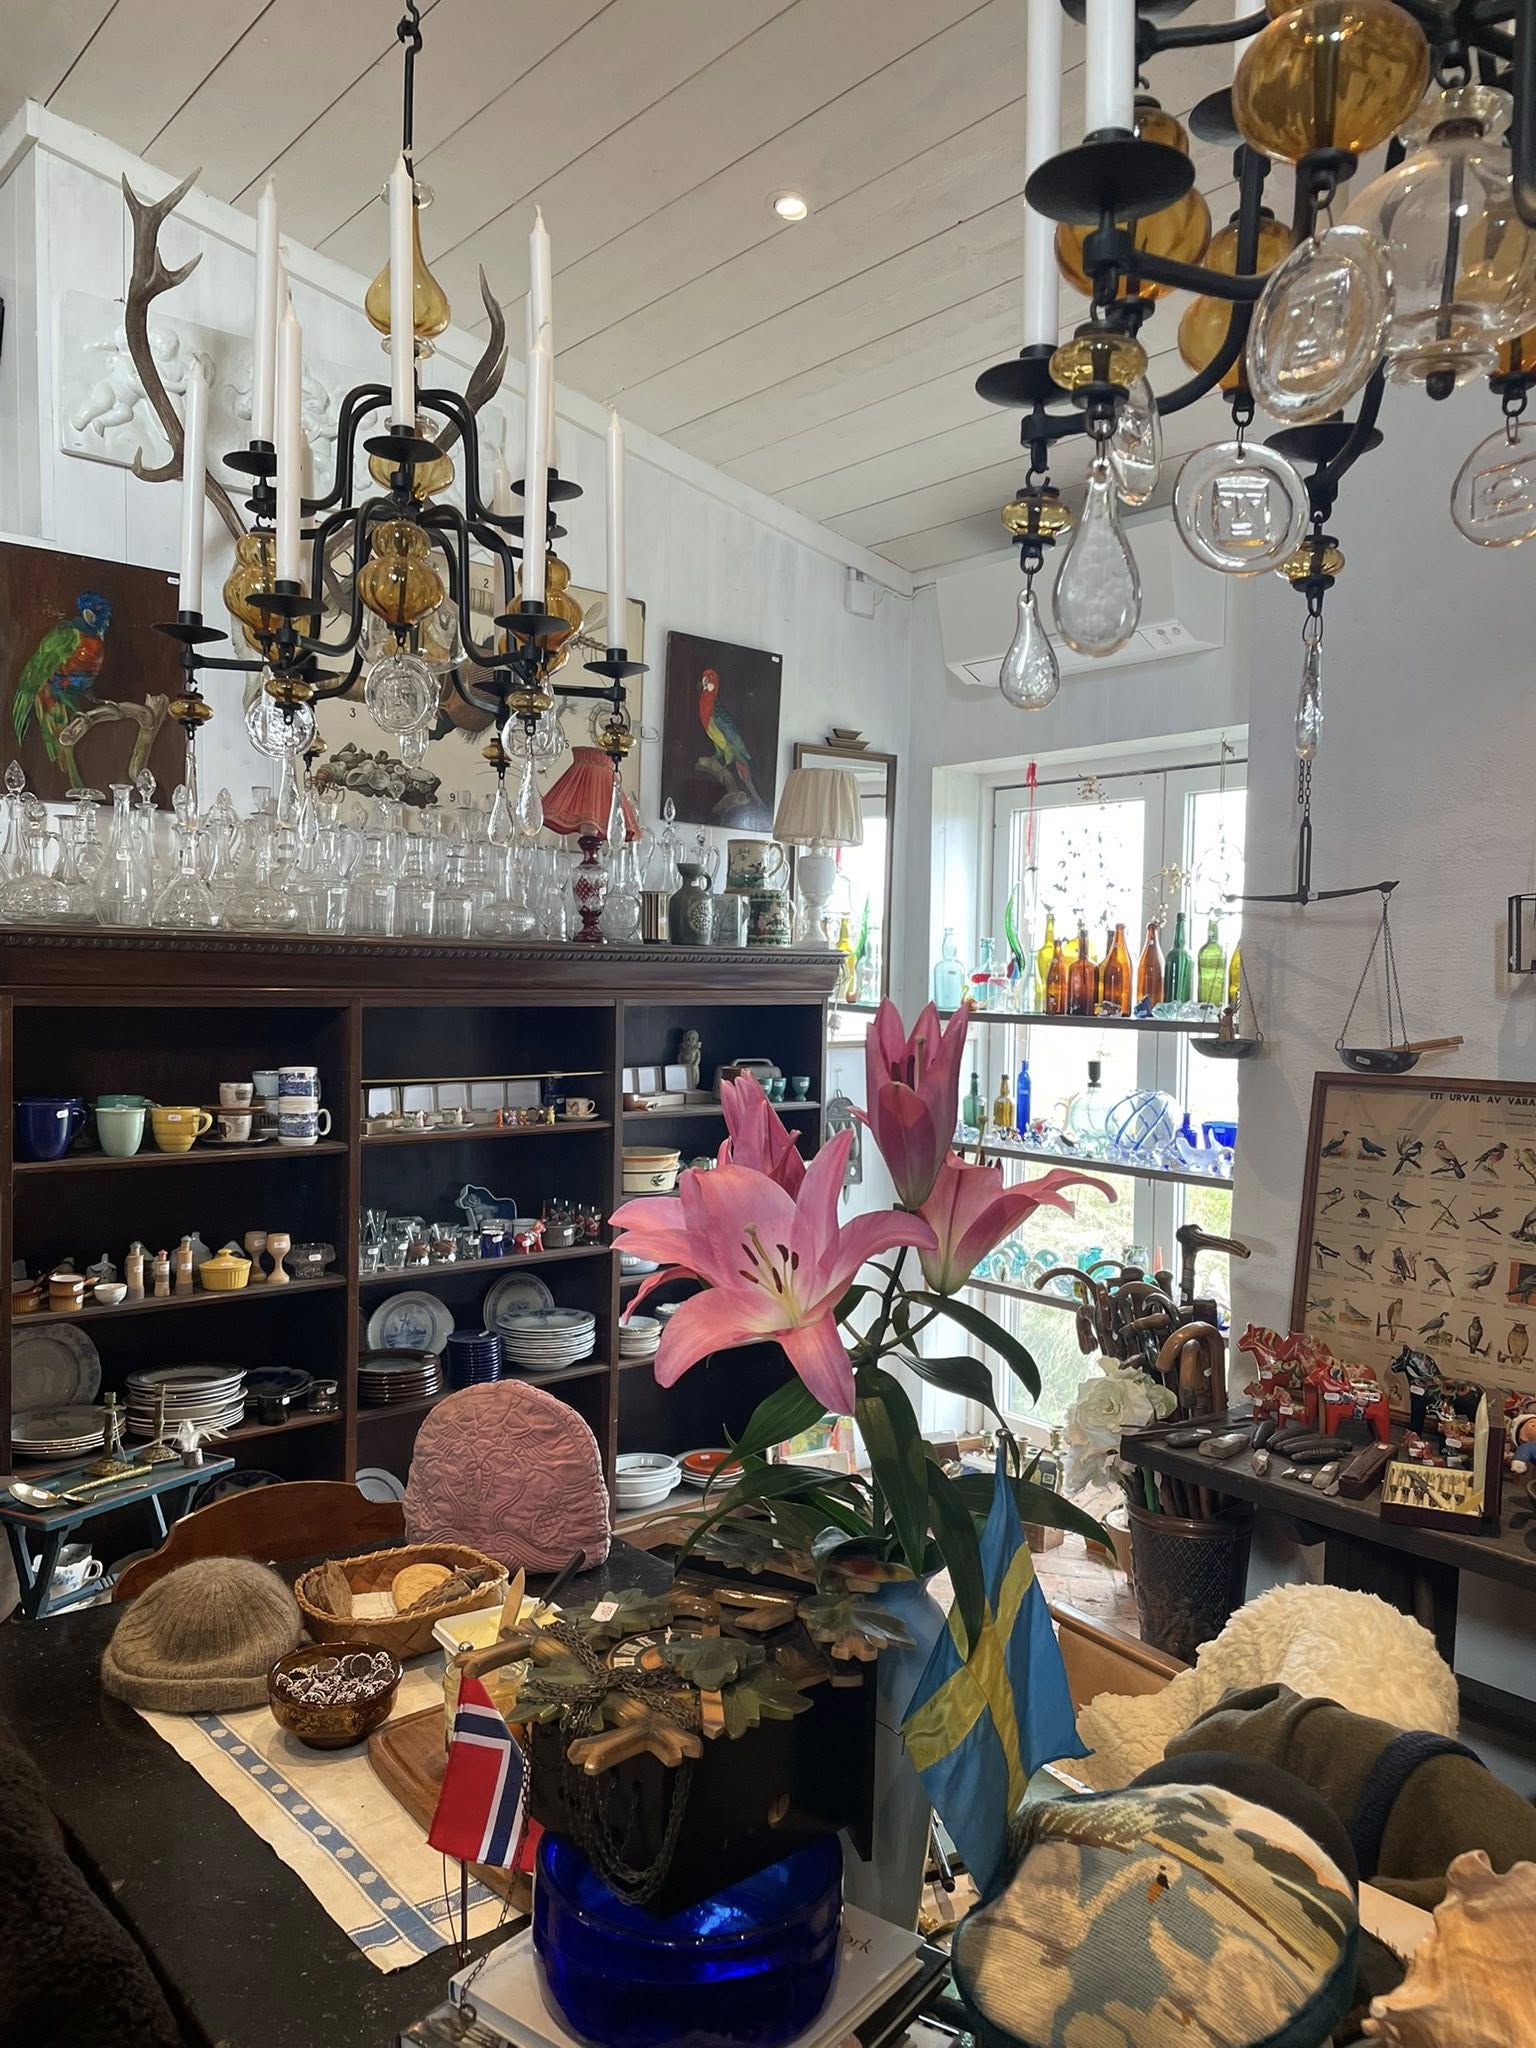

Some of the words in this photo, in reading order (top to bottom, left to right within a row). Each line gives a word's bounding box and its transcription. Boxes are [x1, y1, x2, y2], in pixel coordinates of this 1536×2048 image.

[484, 578, 489, 588] 2
[350, 707, 356, 718] 3
[450, 793, 456, 803] 9
[1430, 1092, 1444, 1100] ETT
[1449, 1093, 1481, 1103] URVAL
[1487, 1095, 1501, 1104] AV
